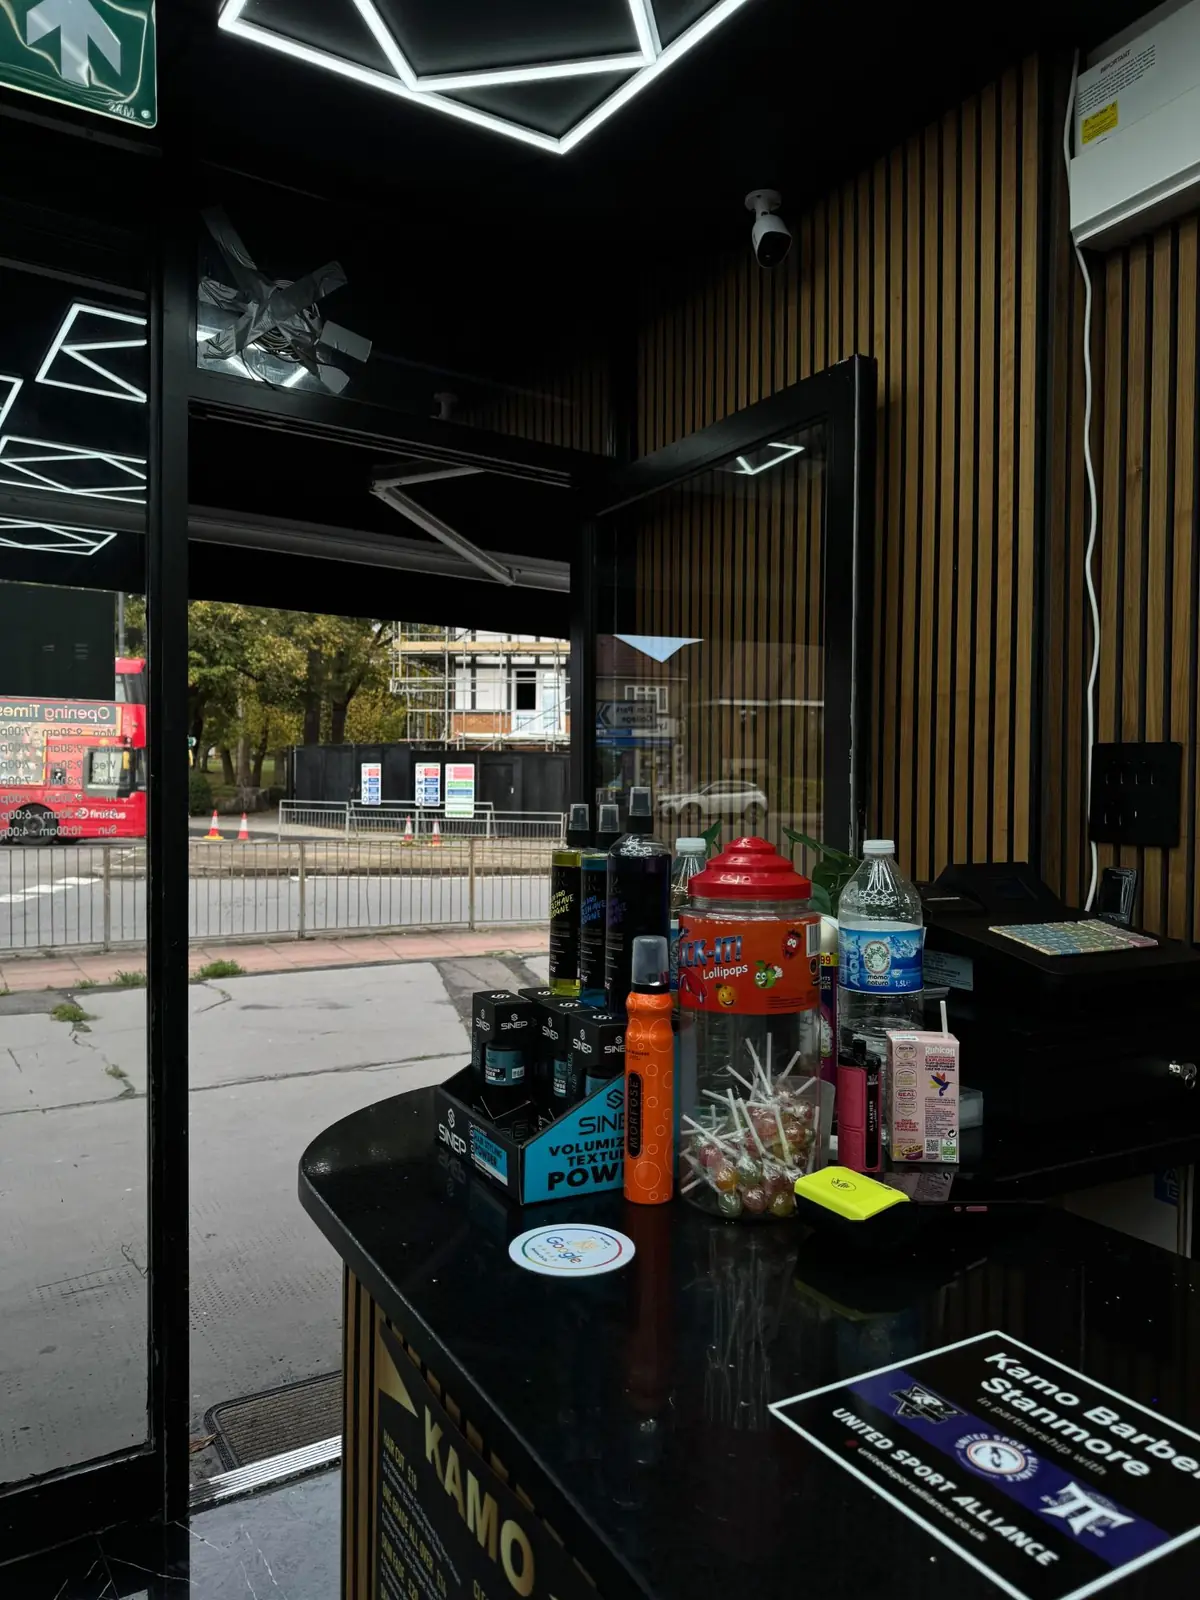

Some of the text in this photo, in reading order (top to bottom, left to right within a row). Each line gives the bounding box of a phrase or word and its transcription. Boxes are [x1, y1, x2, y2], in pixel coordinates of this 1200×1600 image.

[679, 936, 743, 967] ICK-IT!
[702, 964, 749, 980] Lollipops
[475, 1016, 491, 1032] SINEP
[501, 1020, 528, 1031] SINEP
[542, 1026, 559, 1040] SINEP
[572, 1038, 592, 1054] SINEP
[604, 1044, 626, 1054] SINE
[925, 1045, 956, 1057] Rubicon
[578, 1112, 625, 1136] SINE
[629, 1080, 640, 1149] MORFOSE
[438, 1123, 467, 1155] SINEP
[548, 1137, 625, 1156] VOLUMIZ
[567, 1150, 625, 1167] TEXTU
[547, 1162, 625, 1191] POW
[546, 1235, 584, 1264] Google
[983, 1352, 1080, 1406] Kamo
[977, 1396, 989, 1406] in
[1073, 1455, 1108, 1476] with
[981, 1377, 1150, 1477] Stanmore
[954, 1432, 989, 1450] UNITED
[992, 1433, 1033, 1454] SPORT
[831, 1407, 1060, 1567] UNITED SPORT ALLIANCE
[424, 1404, 536, 1597] KAMO
